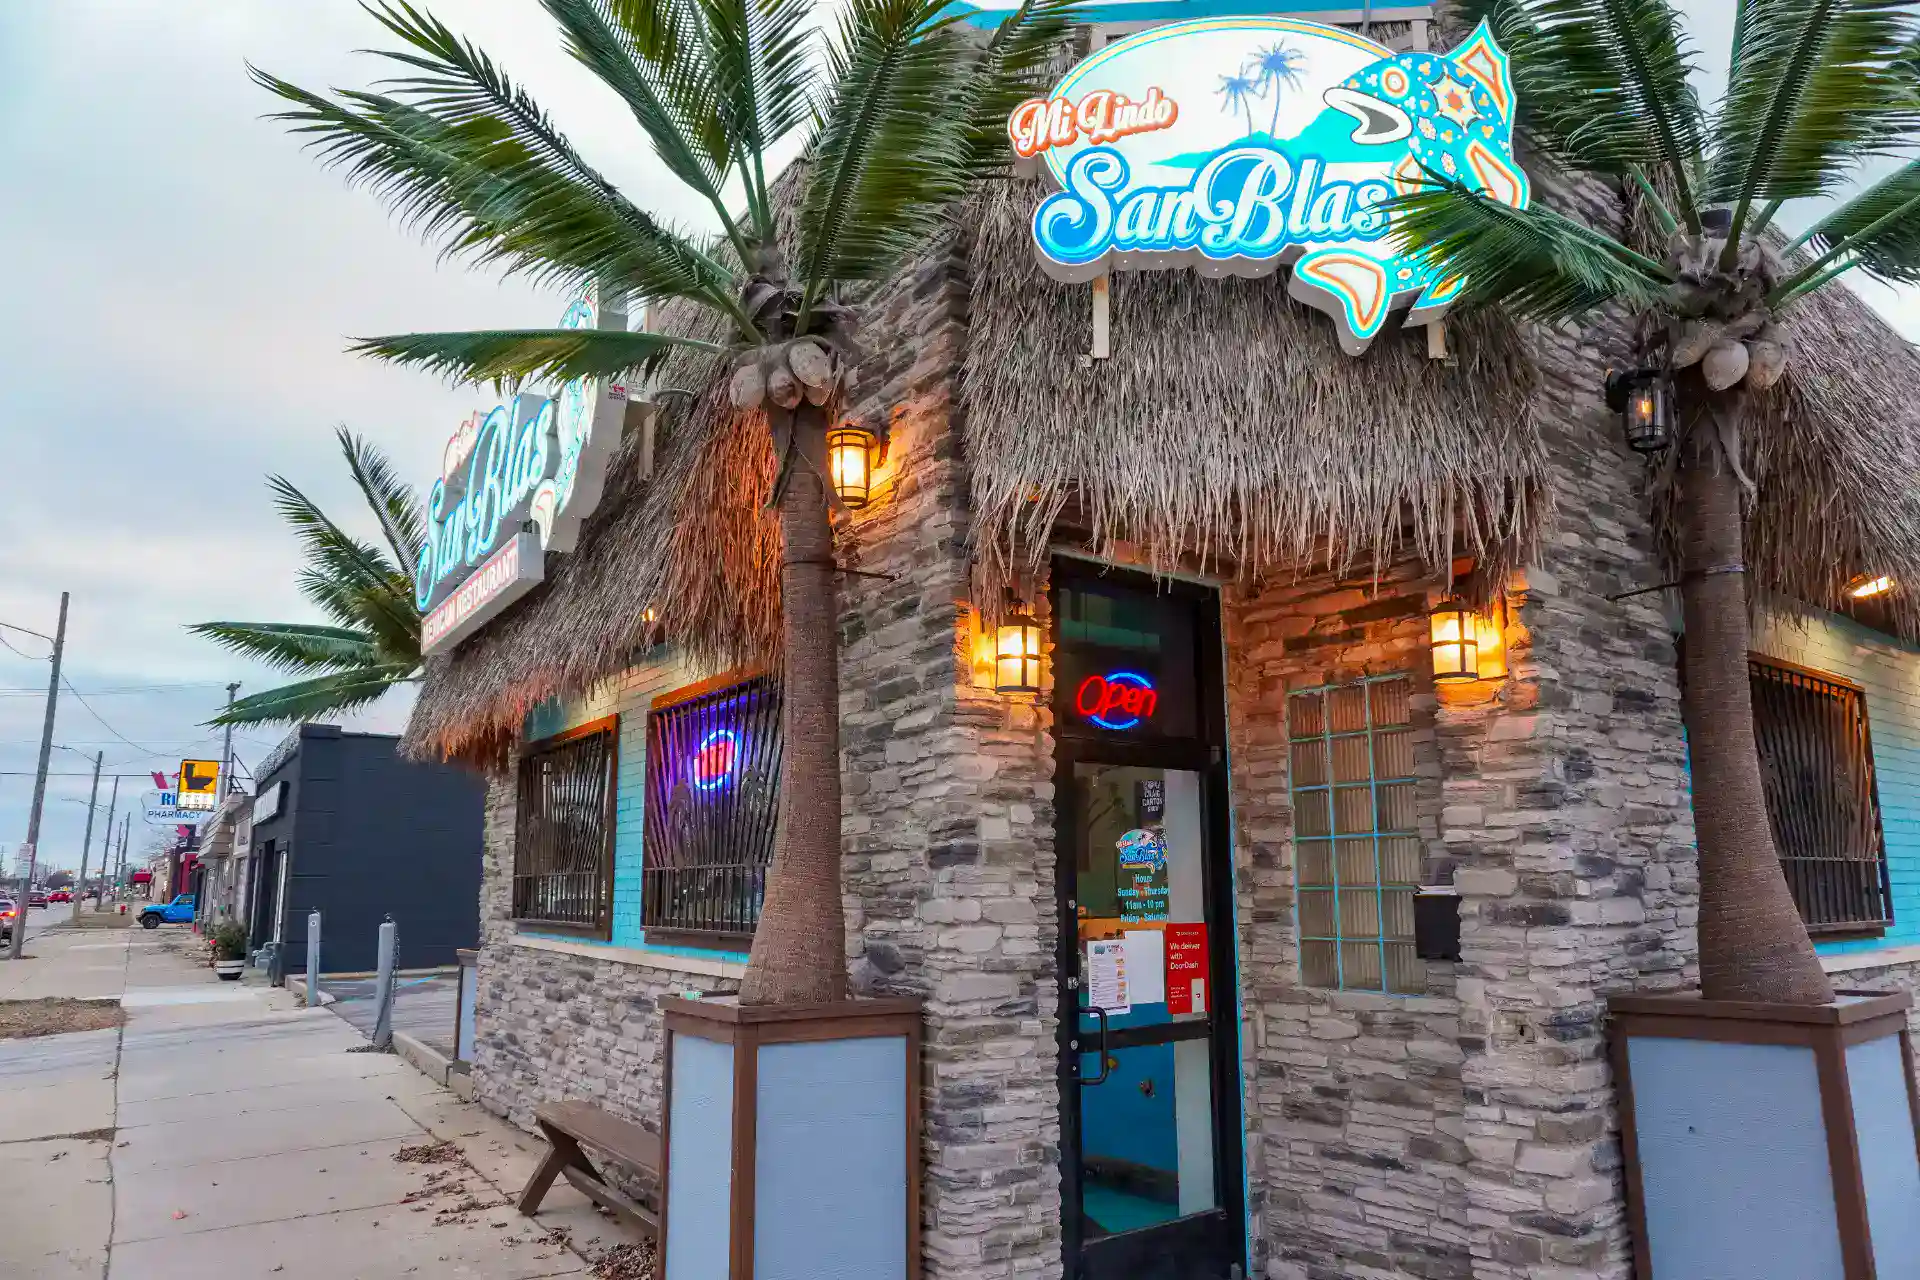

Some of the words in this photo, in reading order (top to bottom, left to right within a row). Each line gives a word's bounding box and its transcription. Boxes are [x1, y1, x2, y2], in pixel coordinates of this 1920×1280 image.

[1010, 98, 1077, 156] Mi
[1076, 87, 1178, 145] Lindo
[465, 394, 552, 566] Blas
[422, 598, 456, 645] MEXICAN
[456, 548, 517, 619] RESTAURANT
[1077, 675, 1157, 720] Open
[148, 810, 202, 819] PHARMACY
[1135, 874, 1153, 883] Hours
[1117, 887, 1139, 898] Sunday
[1144, 885, 1170, 897] Thursday
[1125, 900, 1143, 910] 11am
[1155, 900, 1165, 910] pm
[1120, 913, 1140, 925] Friday
[1144, 912, 1169, 923] Saturday
[1181, 942, 1200, 950] deliver
[1170, 952, 1183, 960] with
[1170, 961, 1199, 970] DoorDash
